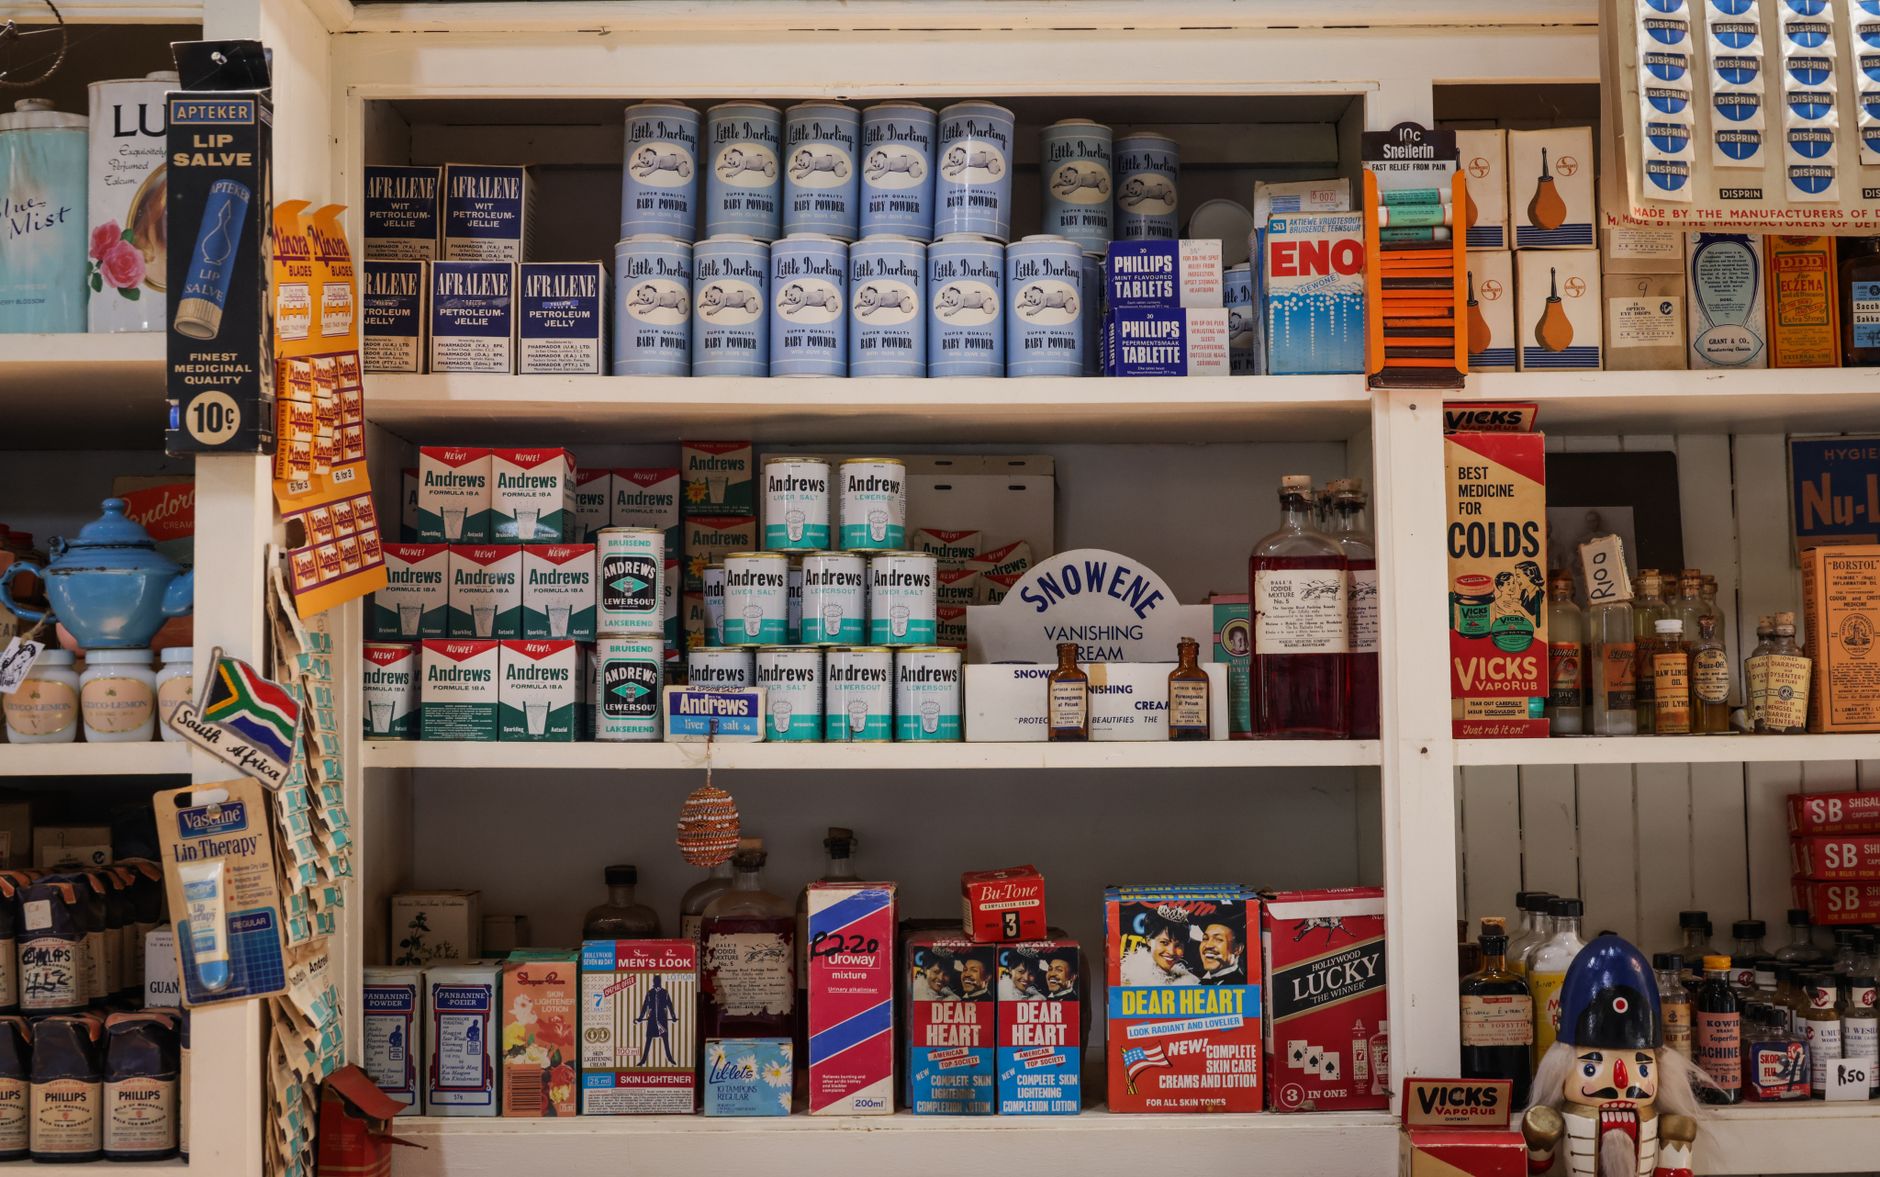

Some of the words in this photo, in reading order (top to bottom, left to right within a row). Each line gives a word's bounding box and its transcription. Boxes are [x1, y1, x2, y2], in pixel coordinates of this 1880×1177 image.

[1648, 21, 1685, 29] DISPRIN
[1718, 60, 1756, 69] DISPRIN
[1792, 95, 1829, 104] DISPRIN
[176, 106, 249, 120] APTEKER
[193, 134, 234, 148] LIP
[628, 121, 654, 143] Little
[657, 121, 696, 151] Darling
[787, 121, 810, 145] Little
[813, 123, 854, 152] Darling
[109, 158, 149, 172] Perfumed
[172, 153, 252, 167] SALVE
[367, 176, 435, 199] AFRALENE
[450, 176, 520, 199] AFRALENE
[636, 198, 654, 210] BABY
[658, 200, 687, 212] POWDER
[794, 200, 811, 211] BABY
[815, 201, 845, 213] POWDER
[453, 211, 515, 219] PETROLEUM-
[1634, 207, 1665, 218] MADE
[1696, 210, 1722, 218] THE
[1730, 209, 1844, 218] MANUFACTURERS
[1851, 209, 1868, 218] OF
[9, 204, 72, 240] Mist
[467, 220, 500, 228] JELLIE
[1289, 218, 1318, 226] AKTIEWE
[272, 224, 310, 269] Minora
[1114, 255, 1172, 273] PHILLIPS
[1271, 239, 1364, 277] ENO
[289, 265, 312, 277] BLADES
[437, 273, 508, 296] AFRALENE
[1115, 281, 1173, 298] TABLETS
[1300, 274, 1336, 293] GEWONE
[1781, 280, 1823, 292] ECZEMA
[1122, 320, 1180, 338] PHILLIPS
[189, 352, 238, 361] FINEST
[1122, 346, 1180, 364] TABLETTE
[174, 364, 252, 373] MEDICINAL
[184, 375, 241, 385] QUALITY
[1445, 410, 1522, 431] VICKS
[444, 452, 467, 460] NEW!
[515, 453, 540, 462] NUWE!
[425, 471, 485, 488] Andrews
[1458, 466, 1489, 479] BEST
[498, 472, 557, 489] Andrews
[848, 475, 901, 494] Andrews
[1458, 484, 1514, 497] MEDICINE
[1459, 501, 1482, 515] FOR
[1448, 520, 1540, 558] COLDS
[604, 561, 656, 580] ANDREWS
[727, 569, 784, 588] Andrews
[1020, 560, 1165, 620] SNOWENE
[604, 598, 655, 606] LEWERSOUT
[1462, 607, 1488, 619] VICKS
[1043, 625, 1143, 641] VANISHING
[525, 643, 549, 652] NEW!
[506, 664, 569, 681] Andrews
[1454, 656, 1538, 691] VICKS
[680, 694, 748, 716] Andrews
[684, 717, 704, 729] liver
[722, 718, 740, 730] salt
[1092, 716, 1135, 724] BEAUTIFIES
[1484, 725, 1498, 735] rub
[1500, 725, 1508, 735] it
[176, 709, 222, 744] South
[225, 742, 281, 781] Africa
[1811, 798, 1843, 823] SB
[199, 836, 257, 858] Therapy
[1825, 843, 1858, 869] SB
[981, 884, 1038, 901] Bu-Tone
[232, 917, 267, 929] REGULAR
[618, 959, 656, 968] MEN'S
[659, 959, 691, 968] LOOK
[829, 953, 875, 967] Uroway
[1311, 950, 1361, 972] HOLLYWOOD
[832, 971, 867, 979] mixture
[1292, 953, 1380, 1001] LUCKY
[1122, 990, 1175, 1015] DEAR
[1180, 989, 1245, 1014] HEART
[931, 1002, 976, 1023] DEAR
[1017, 1002, 1062, 1023] DEAR
[1129, 1027, 1150, 1037] LOOK
[1152, 1023, 1185, 1035] RADIANT
[1187, 1022, 1203, 1030] AND
[1205, 1017, 1240, 1029] LOVELIER
[926, 1025, 981, 1047] HEART
[1012, 1025, 1067, 1047] HEART
[1019, 1048, 1050, 1059] AMERICAN
[1168, 1039, 1208, 1056] NEW!
[1206, 1045, 1257, 1059] COMPLETE
[1040, 1056, 1064, 1065] SOCIETY
[1206, 1059, 1230, 1073] SKIN
[1231, 1059, 1257, 1073] CARE
[620, 1076, 641, 1084] SKIN
[1017, 1074, 1055, 1086] COMPLETE
[1059, 1074, 1078, 1085] SKIN
[1159, 1075, 1199, 1088] CREAMS
[1201, 1075, 1221, 1088] AND
[1222, 1074, 1257, 1088] LOTION
[1838, 1065, 1865, 1086] R50
[45, 1092, 87, 1102] PHILLIPS
[118, 1090, 160, 1100] PHILLIPS
[1017, 1086, 1061, 1098] LIGHTENING
[1286, 1089, 1298, 1101] 3
[1307, 1090, 1321, 1099] IN
[1323, 1089, 1347, 1098] ONE
[855, 1099, 884, 1108] 200ml
[1003, 1101, 1048, 1112] COMPLEXION
[1052, 1100, 1077, 1112] LOTION
[1146, 1099, 1162, 1107] FOR
[1179, 1098, 1199, 1106] SKIN
[1200, 1098, 1226, 1106] TONES
